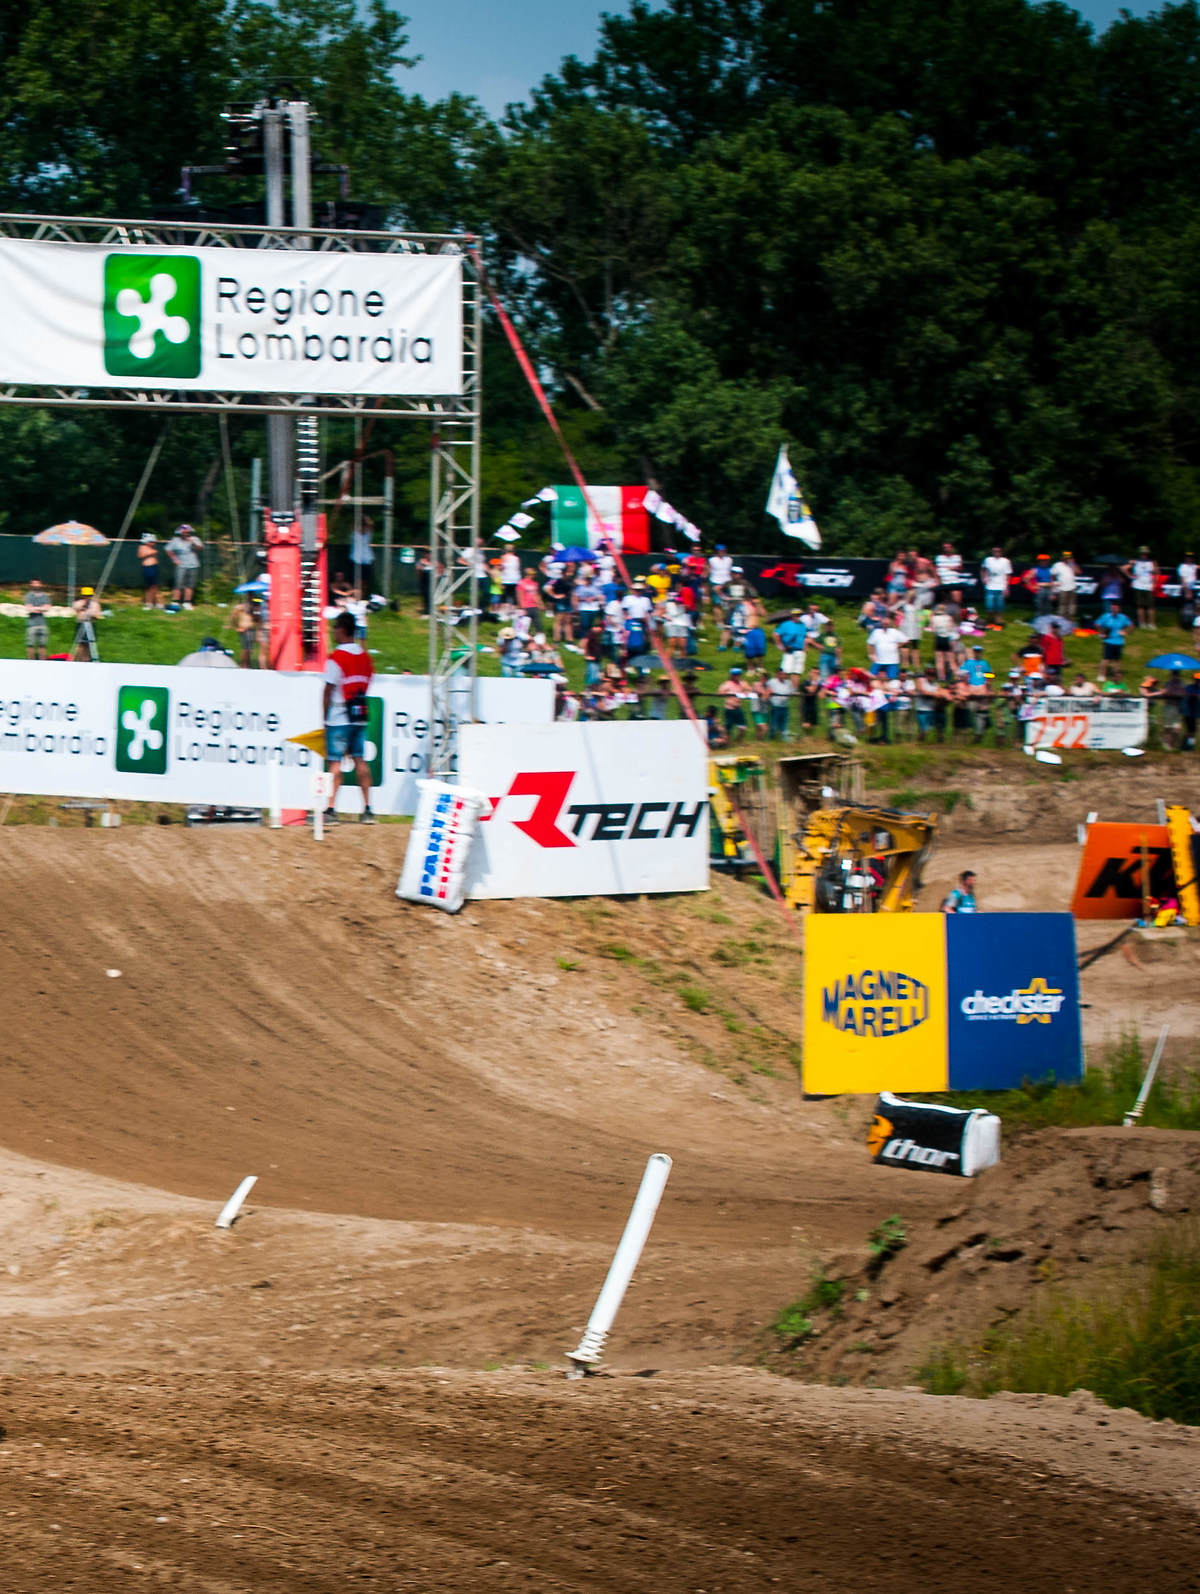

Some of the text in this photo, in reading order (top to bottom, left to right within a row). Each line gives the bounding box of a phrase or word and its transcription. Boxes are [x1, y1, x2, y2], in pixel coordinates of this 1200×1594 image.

[216, 277, 385, 325] Regione
[216, 324, 433, 364] Lombardia
[176, 701, 280, 736] Regione
[175, 735, 310, 767] Lombardia
[1084, 846, 1175, 899] KT
[823, 969, 929, 1002] MAGNETI
[823, 1003, 929, 1037] MARELLI
[882, 1137, 960, 1167] thor
